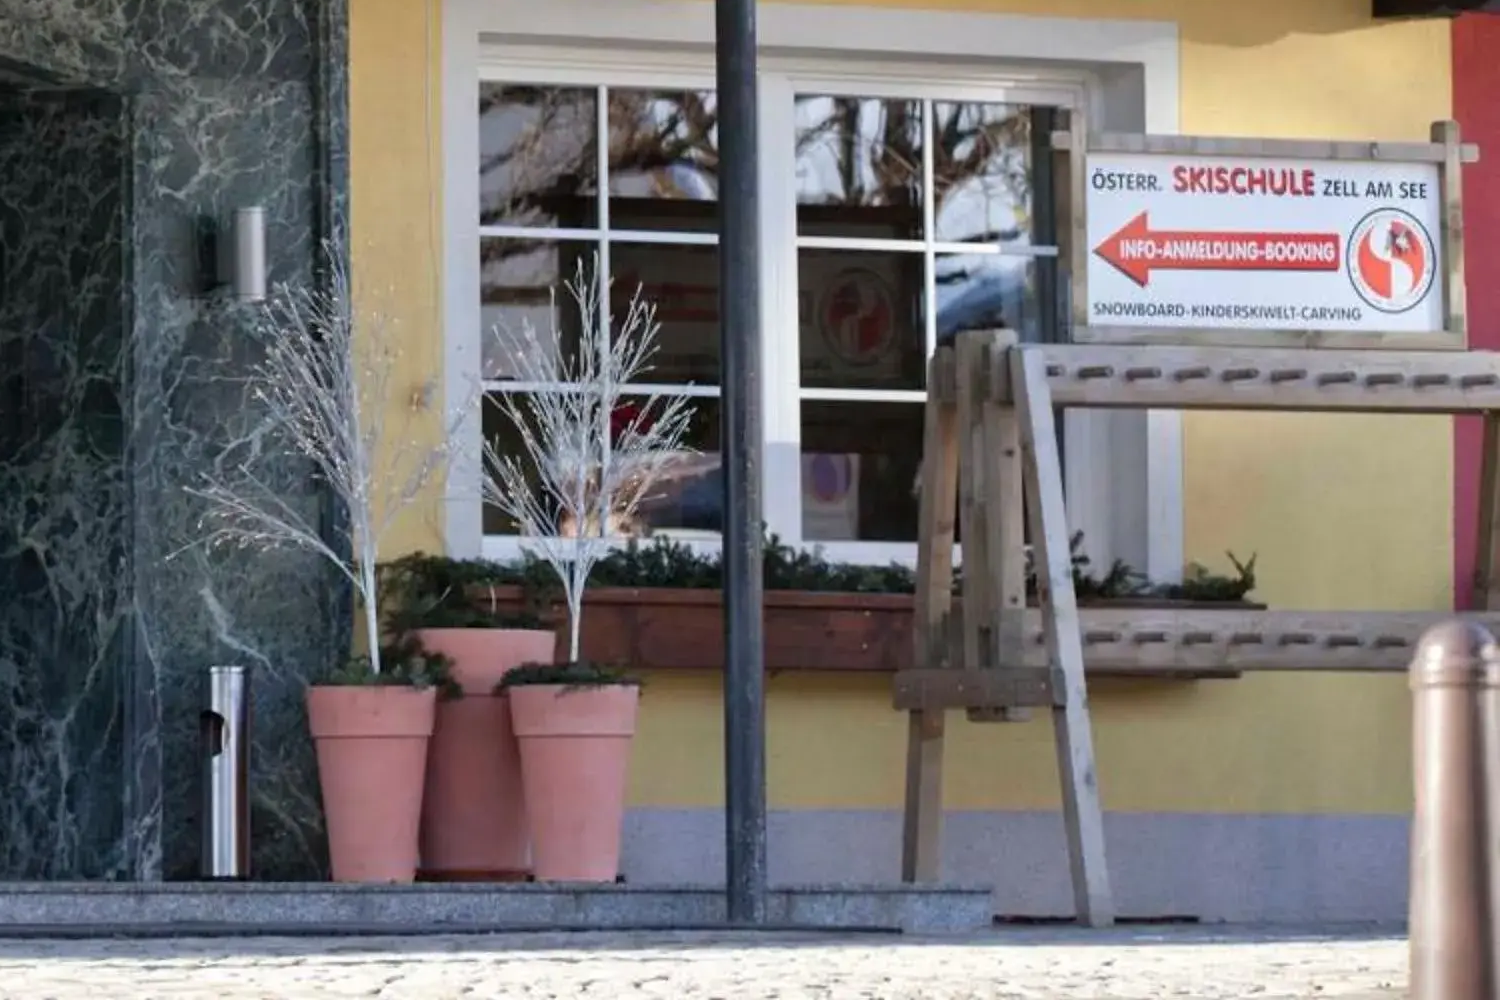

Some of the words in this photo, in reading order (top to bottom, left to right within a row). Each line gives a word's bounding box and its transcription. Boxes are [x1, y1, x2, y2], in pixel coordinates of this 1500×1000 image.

[1173, 165, 1315, 197] SKISCHULE
[1323, 179, 1360, 199] ZELL
[1365, 180, 1394, 200] AM
[1399, 181, 1428, 200] SEE
